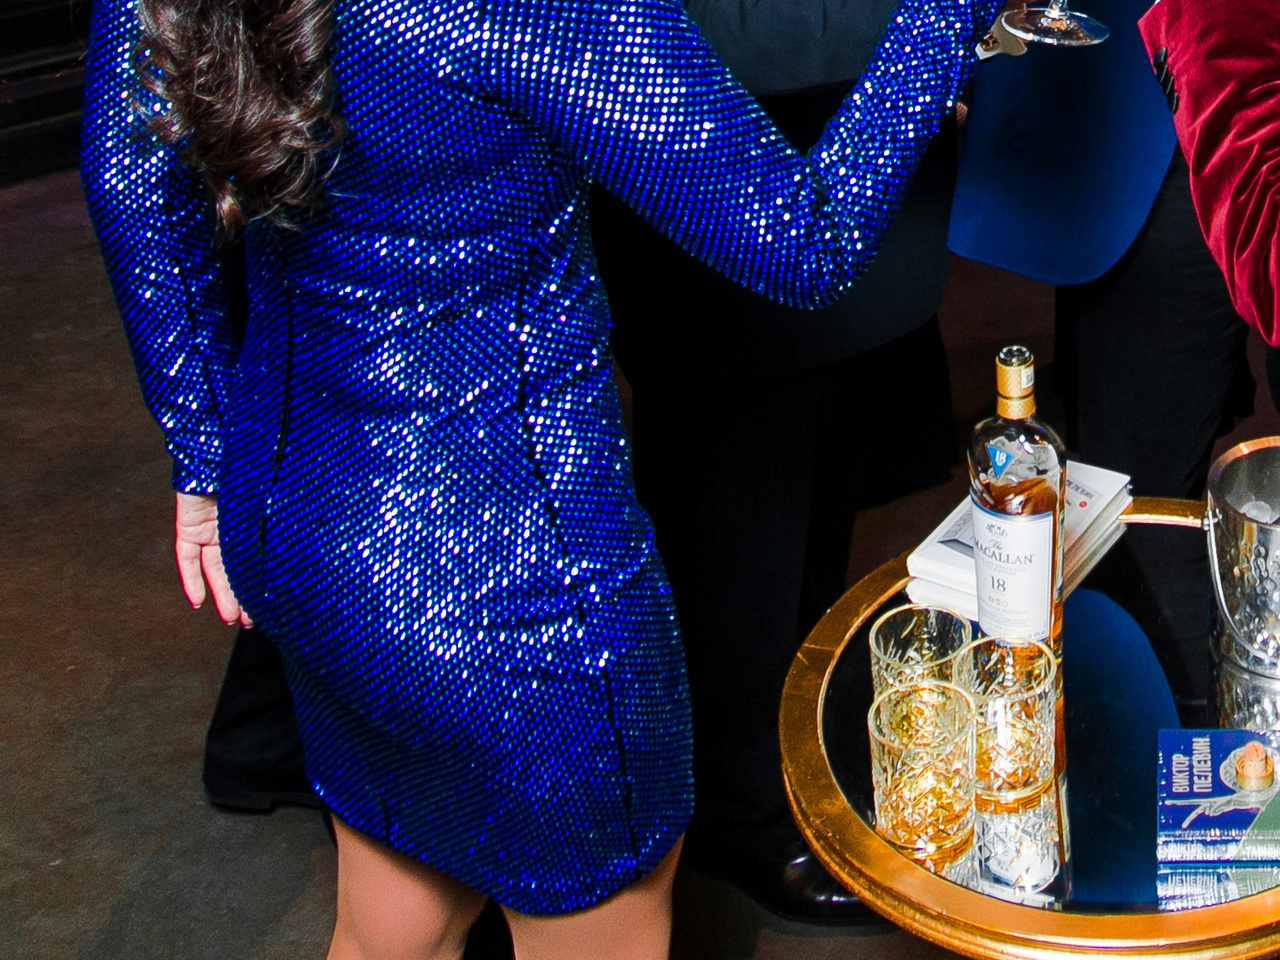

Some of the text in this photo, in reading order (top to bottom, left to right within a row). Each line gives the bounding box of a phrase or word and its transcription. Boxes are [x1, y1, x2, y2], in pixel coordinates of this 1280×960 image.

[995, 449, 1007, 463] 18
[970, 536, 1035, 565] MACALLAN
[990, 576, 1006, 593] 18
[1172, 753, 1191, 793] ВИКТОР
[1192, 737, 1213, 793] ПЕЛЕВИН
